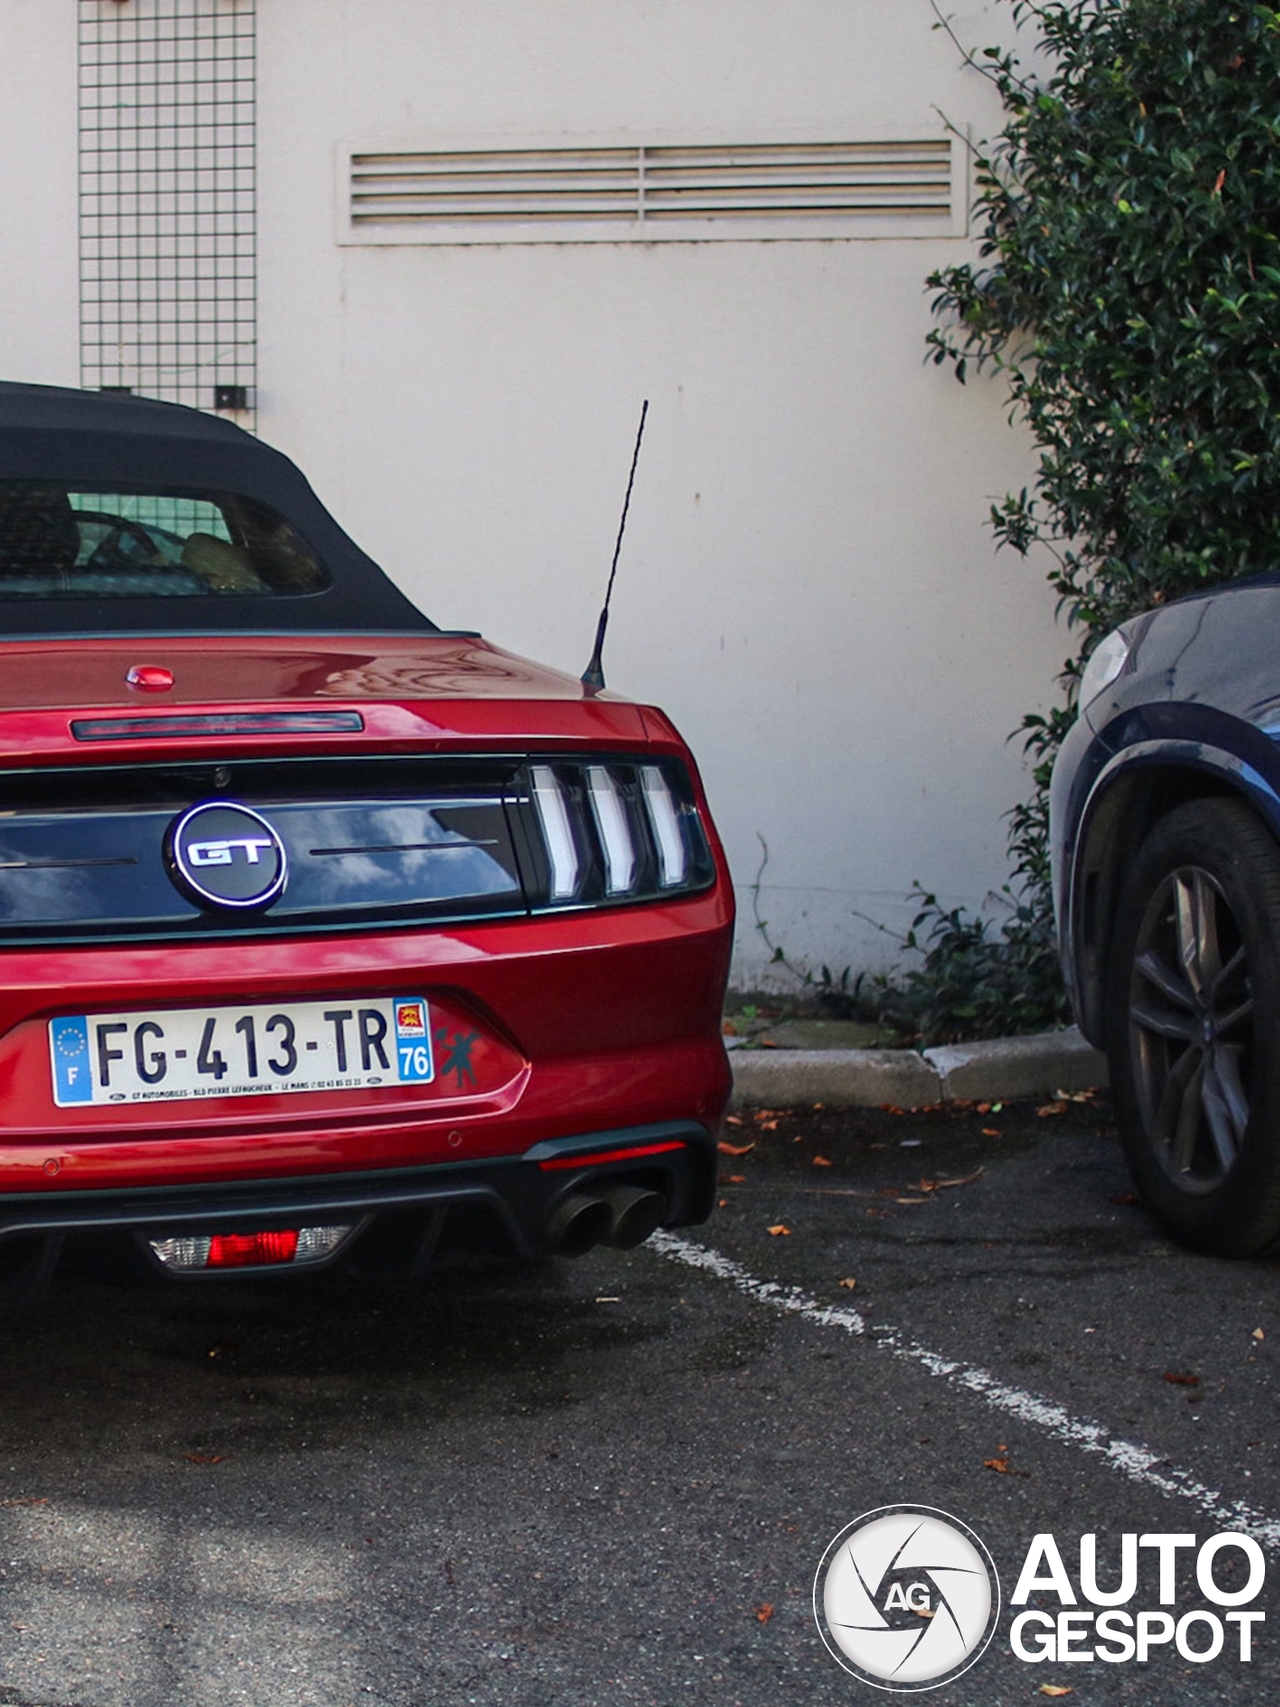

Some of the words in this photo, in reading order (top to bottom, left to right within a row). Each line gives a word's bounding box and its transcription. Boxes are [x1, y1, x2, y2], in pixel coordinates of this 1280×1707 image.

[187, 838, 272, 866] GT
[96, 1009, 391, 1087] FG-413-TR
[399, 1046, 429, 1076] 76
[67, 1067, 79, 1085] F
[142, 1089, 188, 1099] AUTOMOBILES
[207, 1086, 230, 1095] PIERRE
[290, 1081, 309, 1090] MANS
